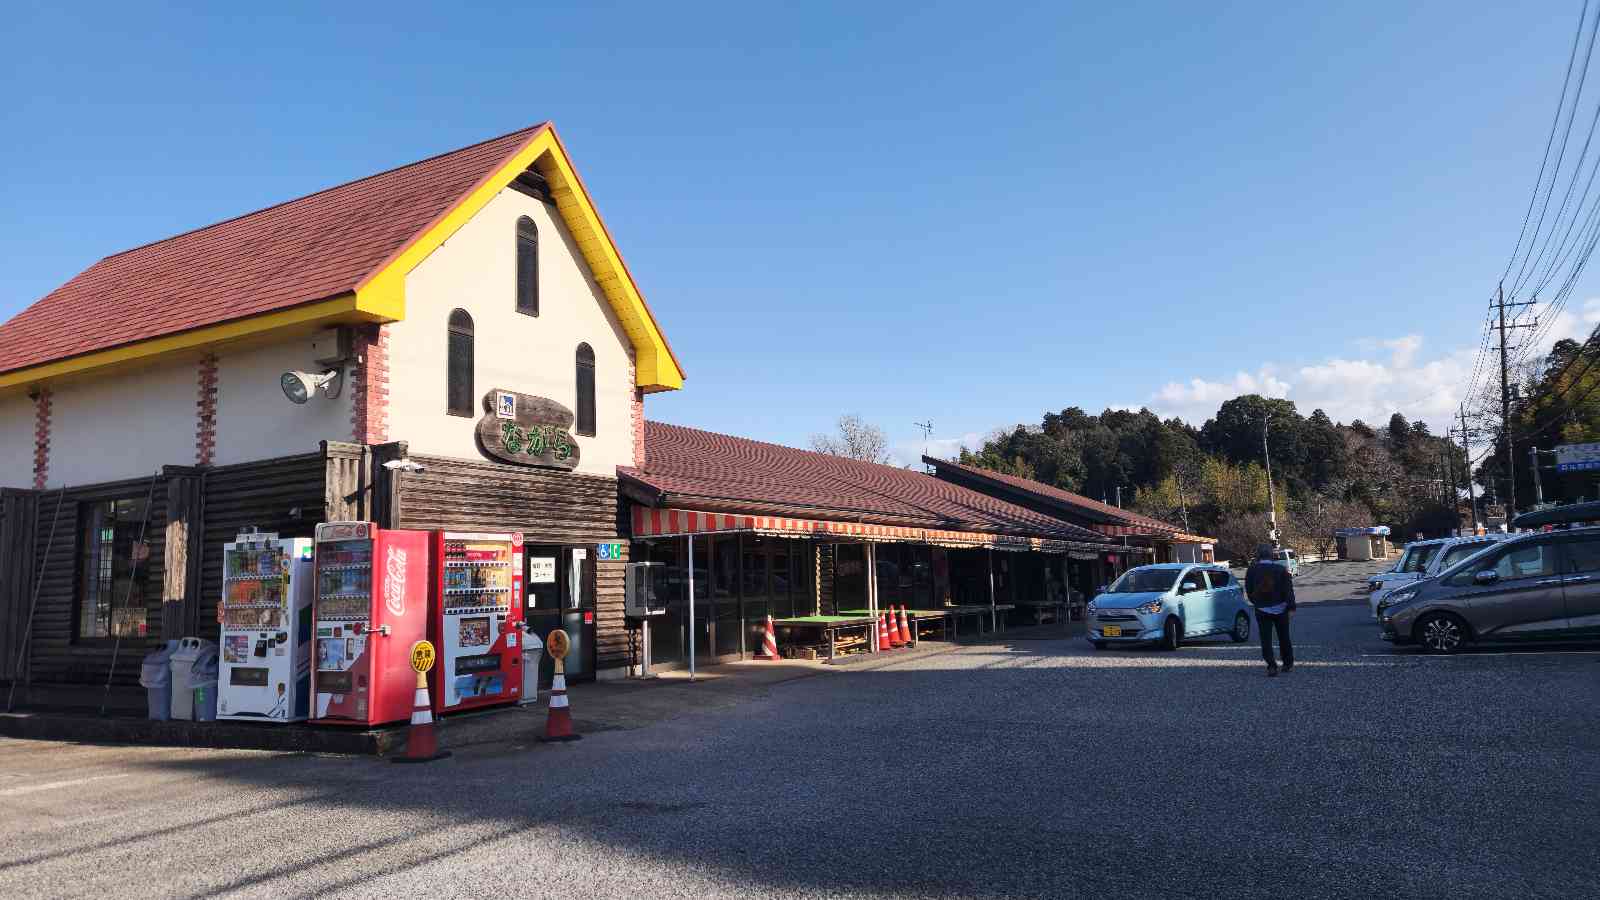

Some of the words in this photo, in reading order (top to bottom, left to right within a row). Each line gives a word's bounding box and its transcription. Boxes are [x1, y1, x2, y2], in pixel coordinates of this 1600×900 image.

[502, 420, 572, 460] ながら
[384, 545, 407, 617] Coca-Cola
